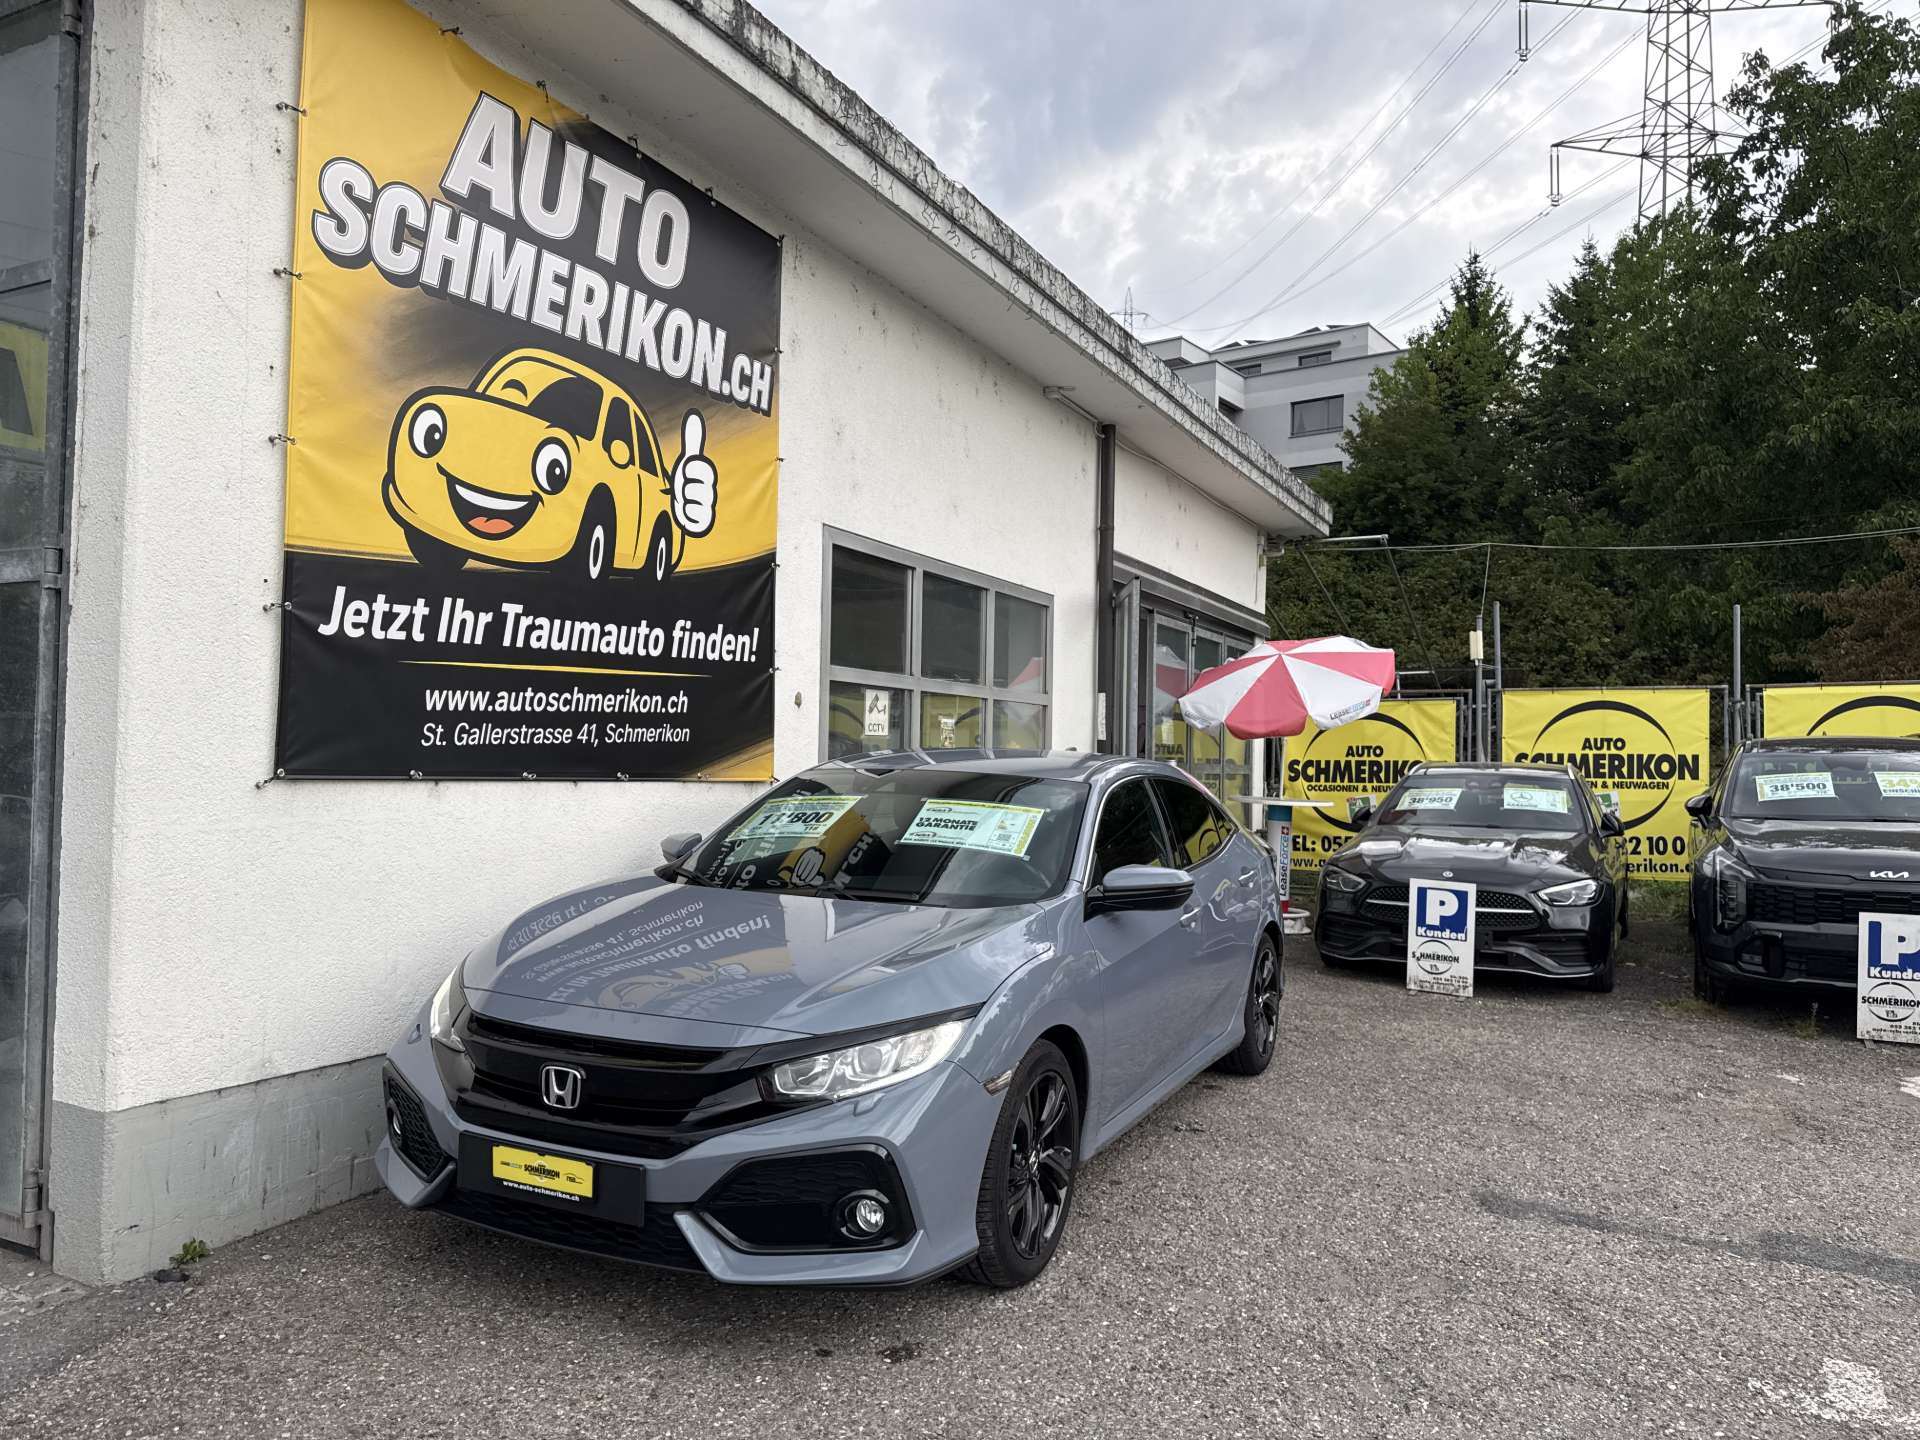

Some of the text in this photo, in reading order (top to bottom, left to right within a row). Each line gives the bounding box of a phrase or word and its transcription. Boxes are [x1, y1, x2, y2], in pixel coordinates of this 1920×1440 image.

[442, 92, 691, 290] AUTO
[314, 159, 773, 412] SCHMERIKON.CH
[318, 585, 759, 662] Jetzt Ihr Traumauto finden!
[425, 687, 688, 714] www.autoschmerikon.ch
[422, 723, 690, 748] St. Gallerstrasse 41, Schmerikon
[868, 723, 885, 733] CCTV
[1345, 746, 1384, 758] AUTO
[1581, 737, 1626, 751] AUTO
[1288, 759, 1423, 784] SCHMERIK
[1307, 784, 1359, 793] OCCASIONEN
[1361, 785, 1369, 793] &
[1601, 781, 1609, 789] &
[1612, 781, 1670, 790] NEUWAGEN
[1769, 782, 1827, 792] 38'500
[915, 822, 977, 832] GARANTIE
[931, 817, 979, 826] MONATE
[1291, 835, 1316, 852] EL:
[1646, 836, 1668, 855] 10
[1672, 836, 1686, 855] 0
[1280, 835, 1289, 896] LeaseForce
[1425, 888, 1459, 926] P
[1417, 926, 1466, 940] Kunden
[1869, 967, 1920, 981] Kunde
[524, 1164, 560, 1179] SCHMERIKON
[503, 1181, 580, 1202] www.auto-schmerikon.ch
